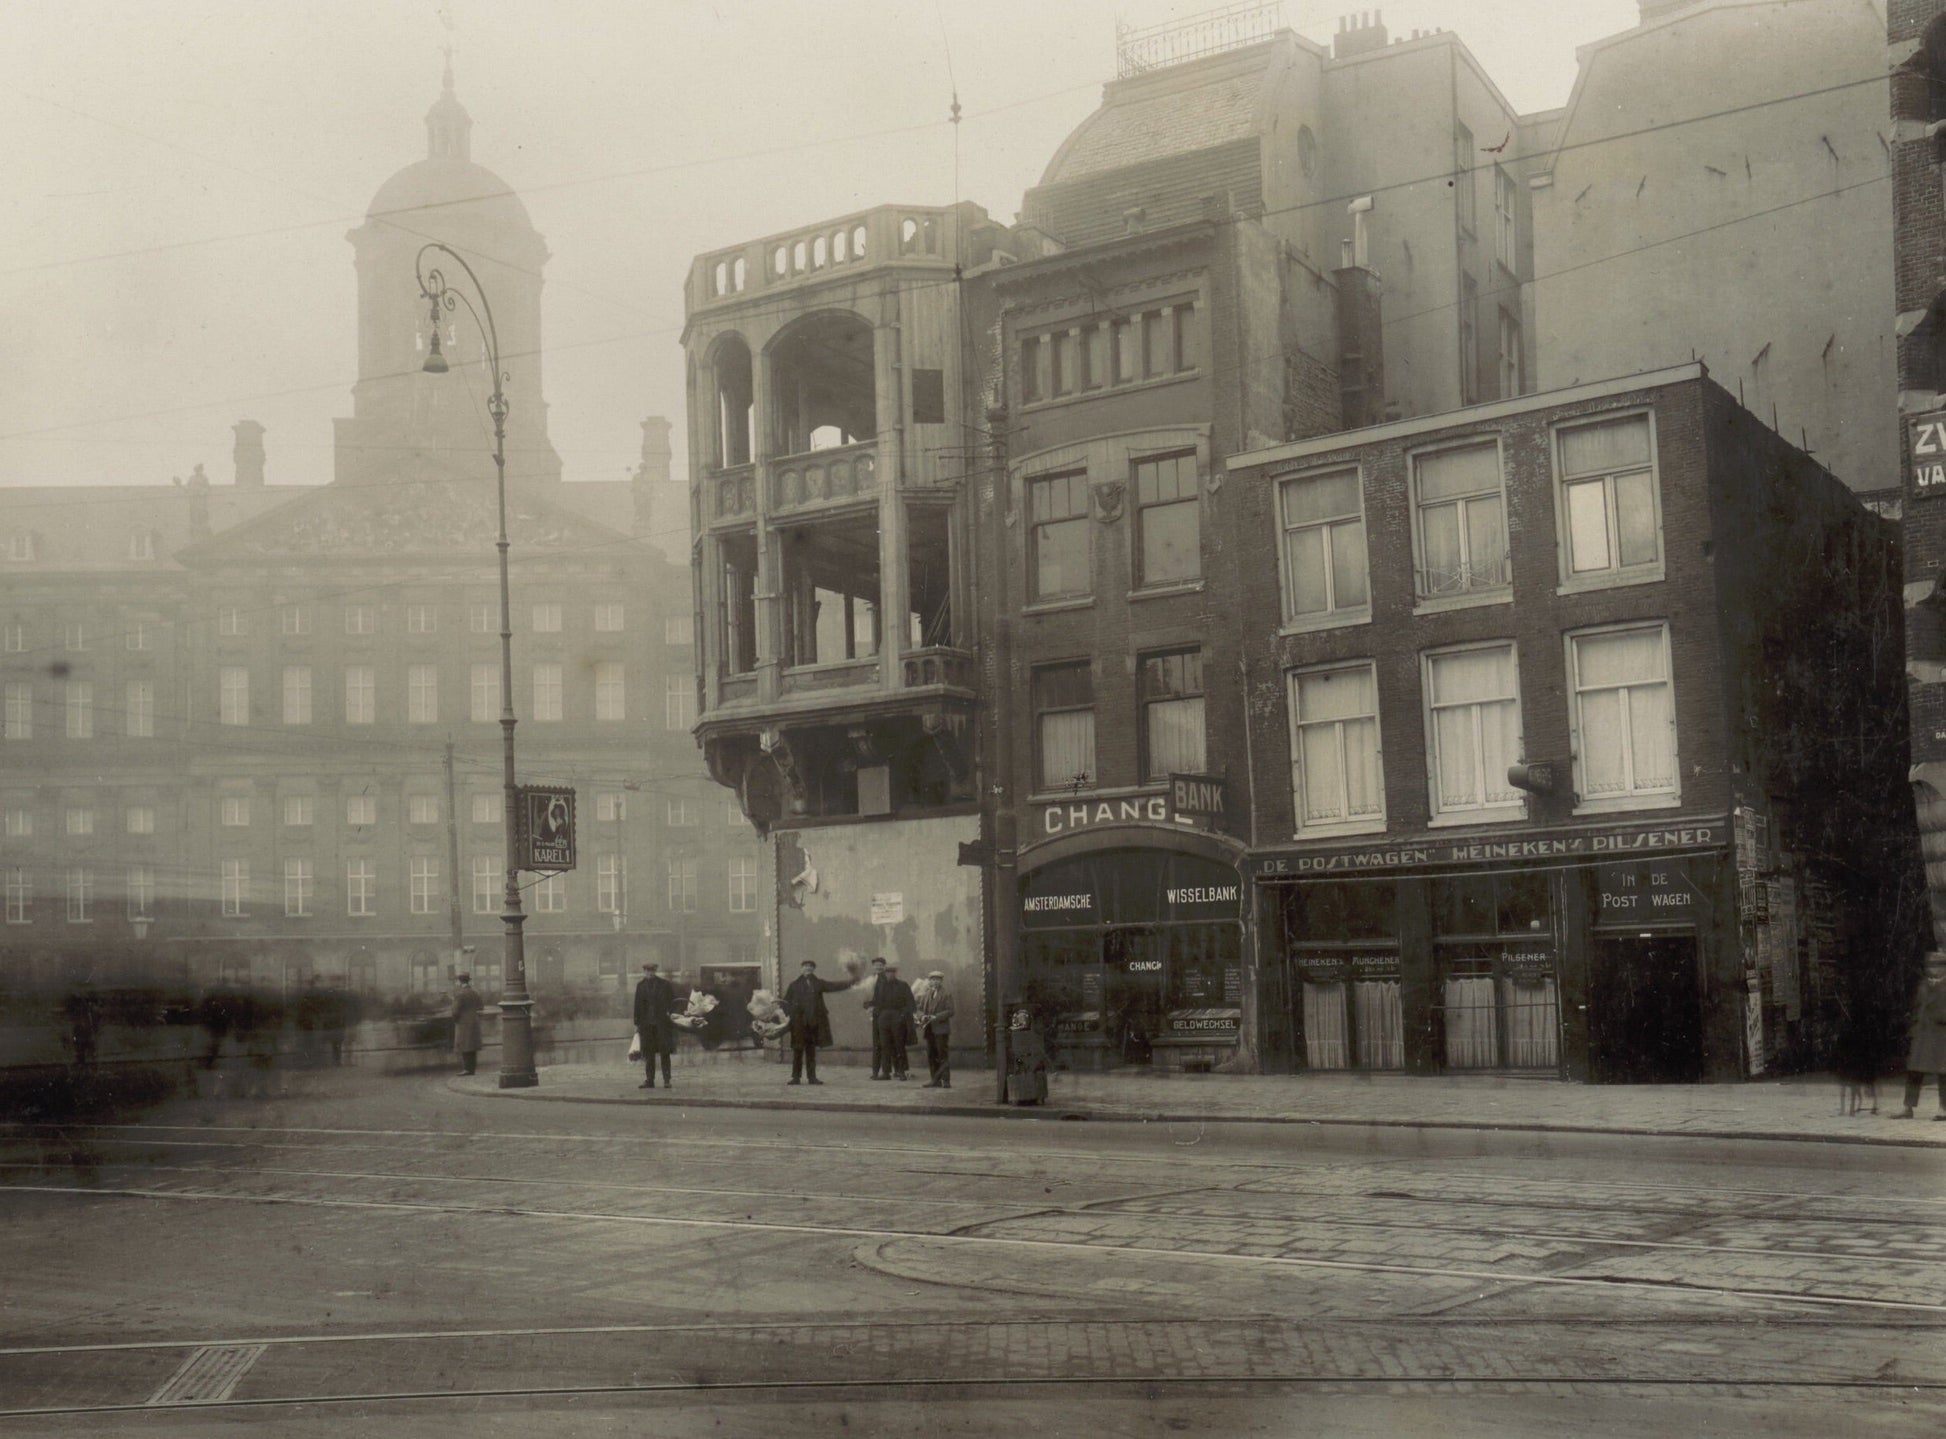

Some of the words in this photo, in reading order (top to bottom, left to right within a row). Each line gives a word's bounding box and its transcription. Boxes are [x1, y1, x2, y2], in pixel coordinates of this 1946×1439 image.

[1174, 780, 1224, 814] BANK
[1453, 837, 1582, 860] HEINEKEN'S
[1593, 828, 1712, 851] PILSENER
[534, 848, 565, 862] KAREL
[1622, 873, 1635, 887] IN
[1652, 872, 1669, 886] DE
[1024, 894, 1091, 912] AMSTERDAMSCHE
[1167, 886, 1237, 904] WISSELBANK
[1651, 892, 1691, 907] WAGEN
[1173, 1019, 1236, 1030] GELDWECHSEL
